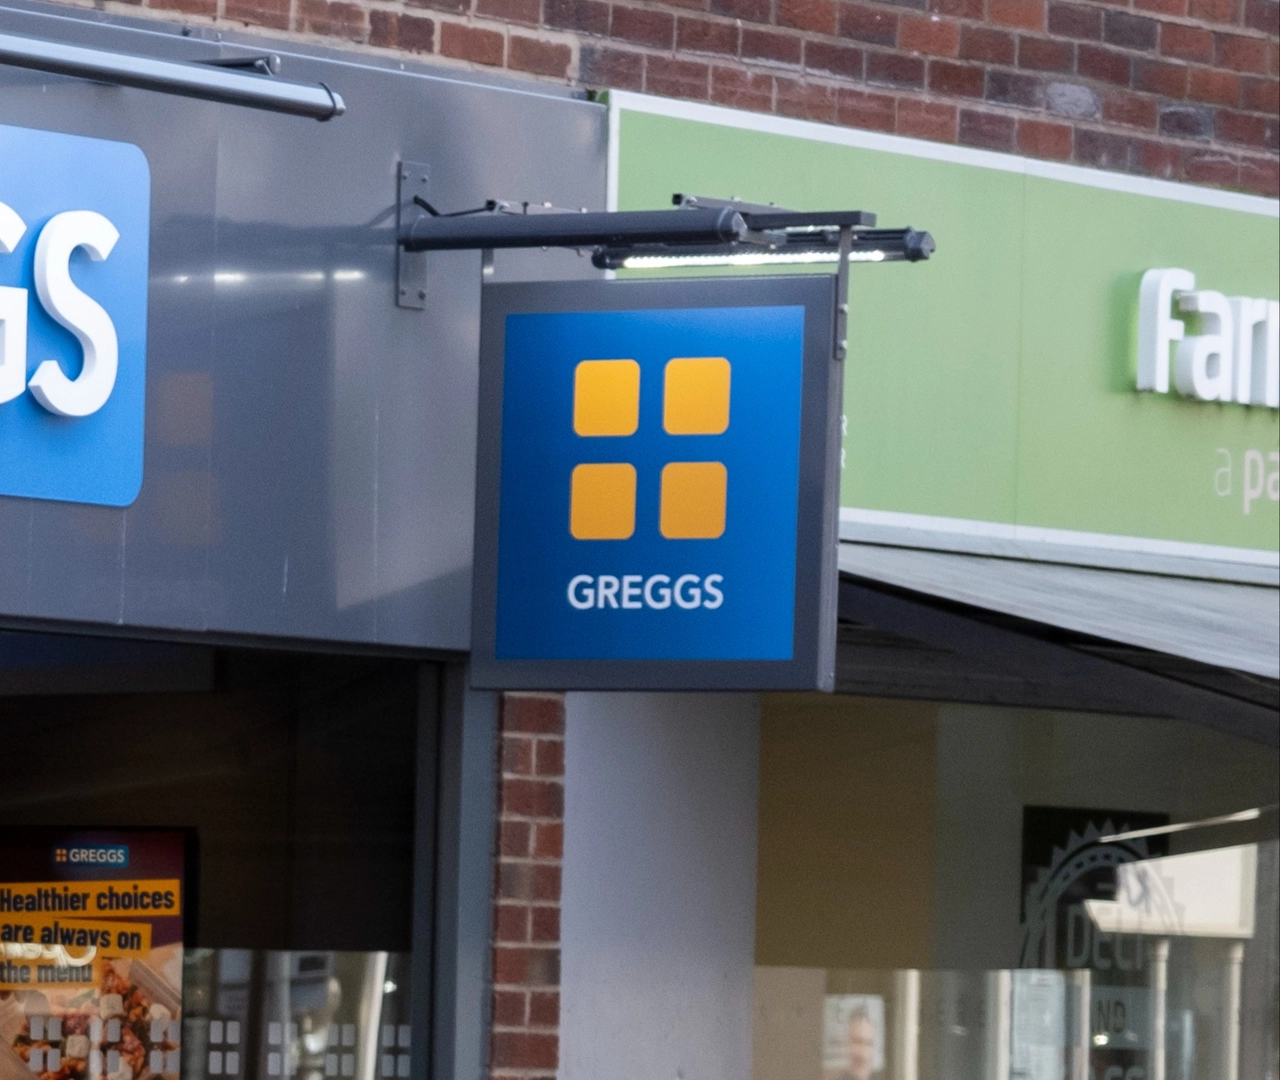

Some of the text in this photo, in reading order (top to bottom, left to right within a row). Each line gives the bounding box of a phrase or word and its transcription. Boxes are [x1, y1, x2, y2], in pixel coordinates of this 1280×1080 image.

[567, 574, 724, 610] GREGGS
[69, 848, 126, 863] GREGGS
[0, 885, 175, 912] Healthier choices
[0, 921, 142, 950] are always on
[0, 960, 93, 984] the menu
